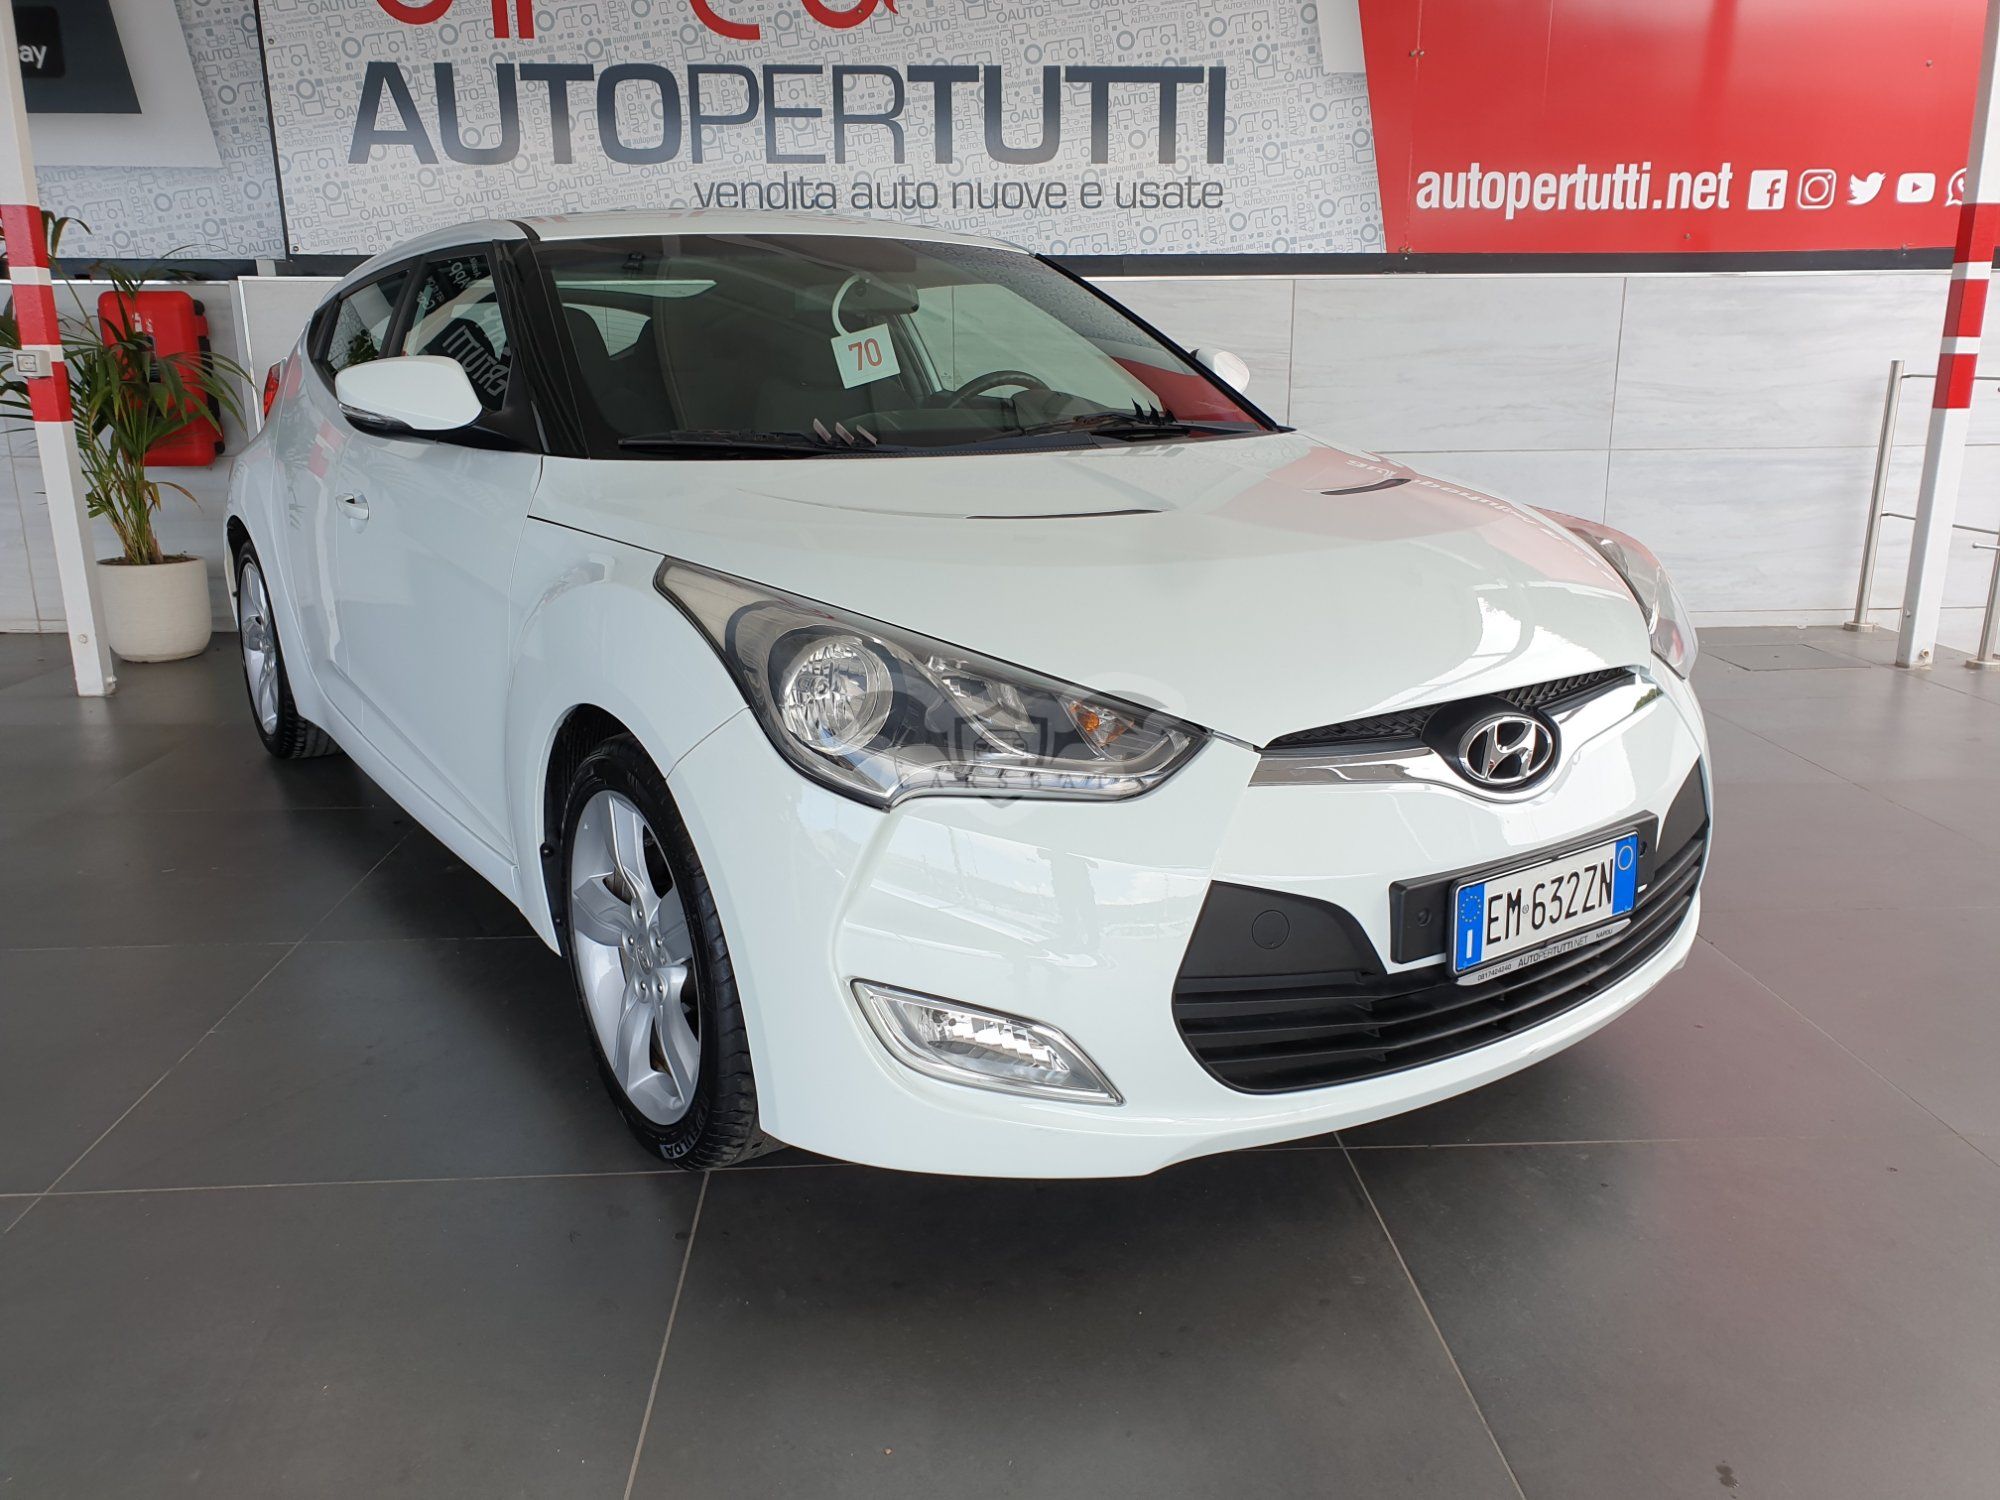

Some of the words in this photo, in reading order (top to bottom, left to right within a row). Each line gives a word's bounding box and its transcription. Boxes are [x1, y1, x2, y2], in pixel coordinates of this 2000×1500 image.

[349, 61, 1226, 166] AUTOPERTUTTI
[694, 171, 836, 210] vendita
[850, 176, 938, 210] auto
[951, 181, 1067, 210] nuove
[1079, 181, 1103, 210] e
[1116, 176, 1224, 210] usate
[1416, 162, 1733, 220] autopertutti.net
[848, 338, 882, 371] 70
